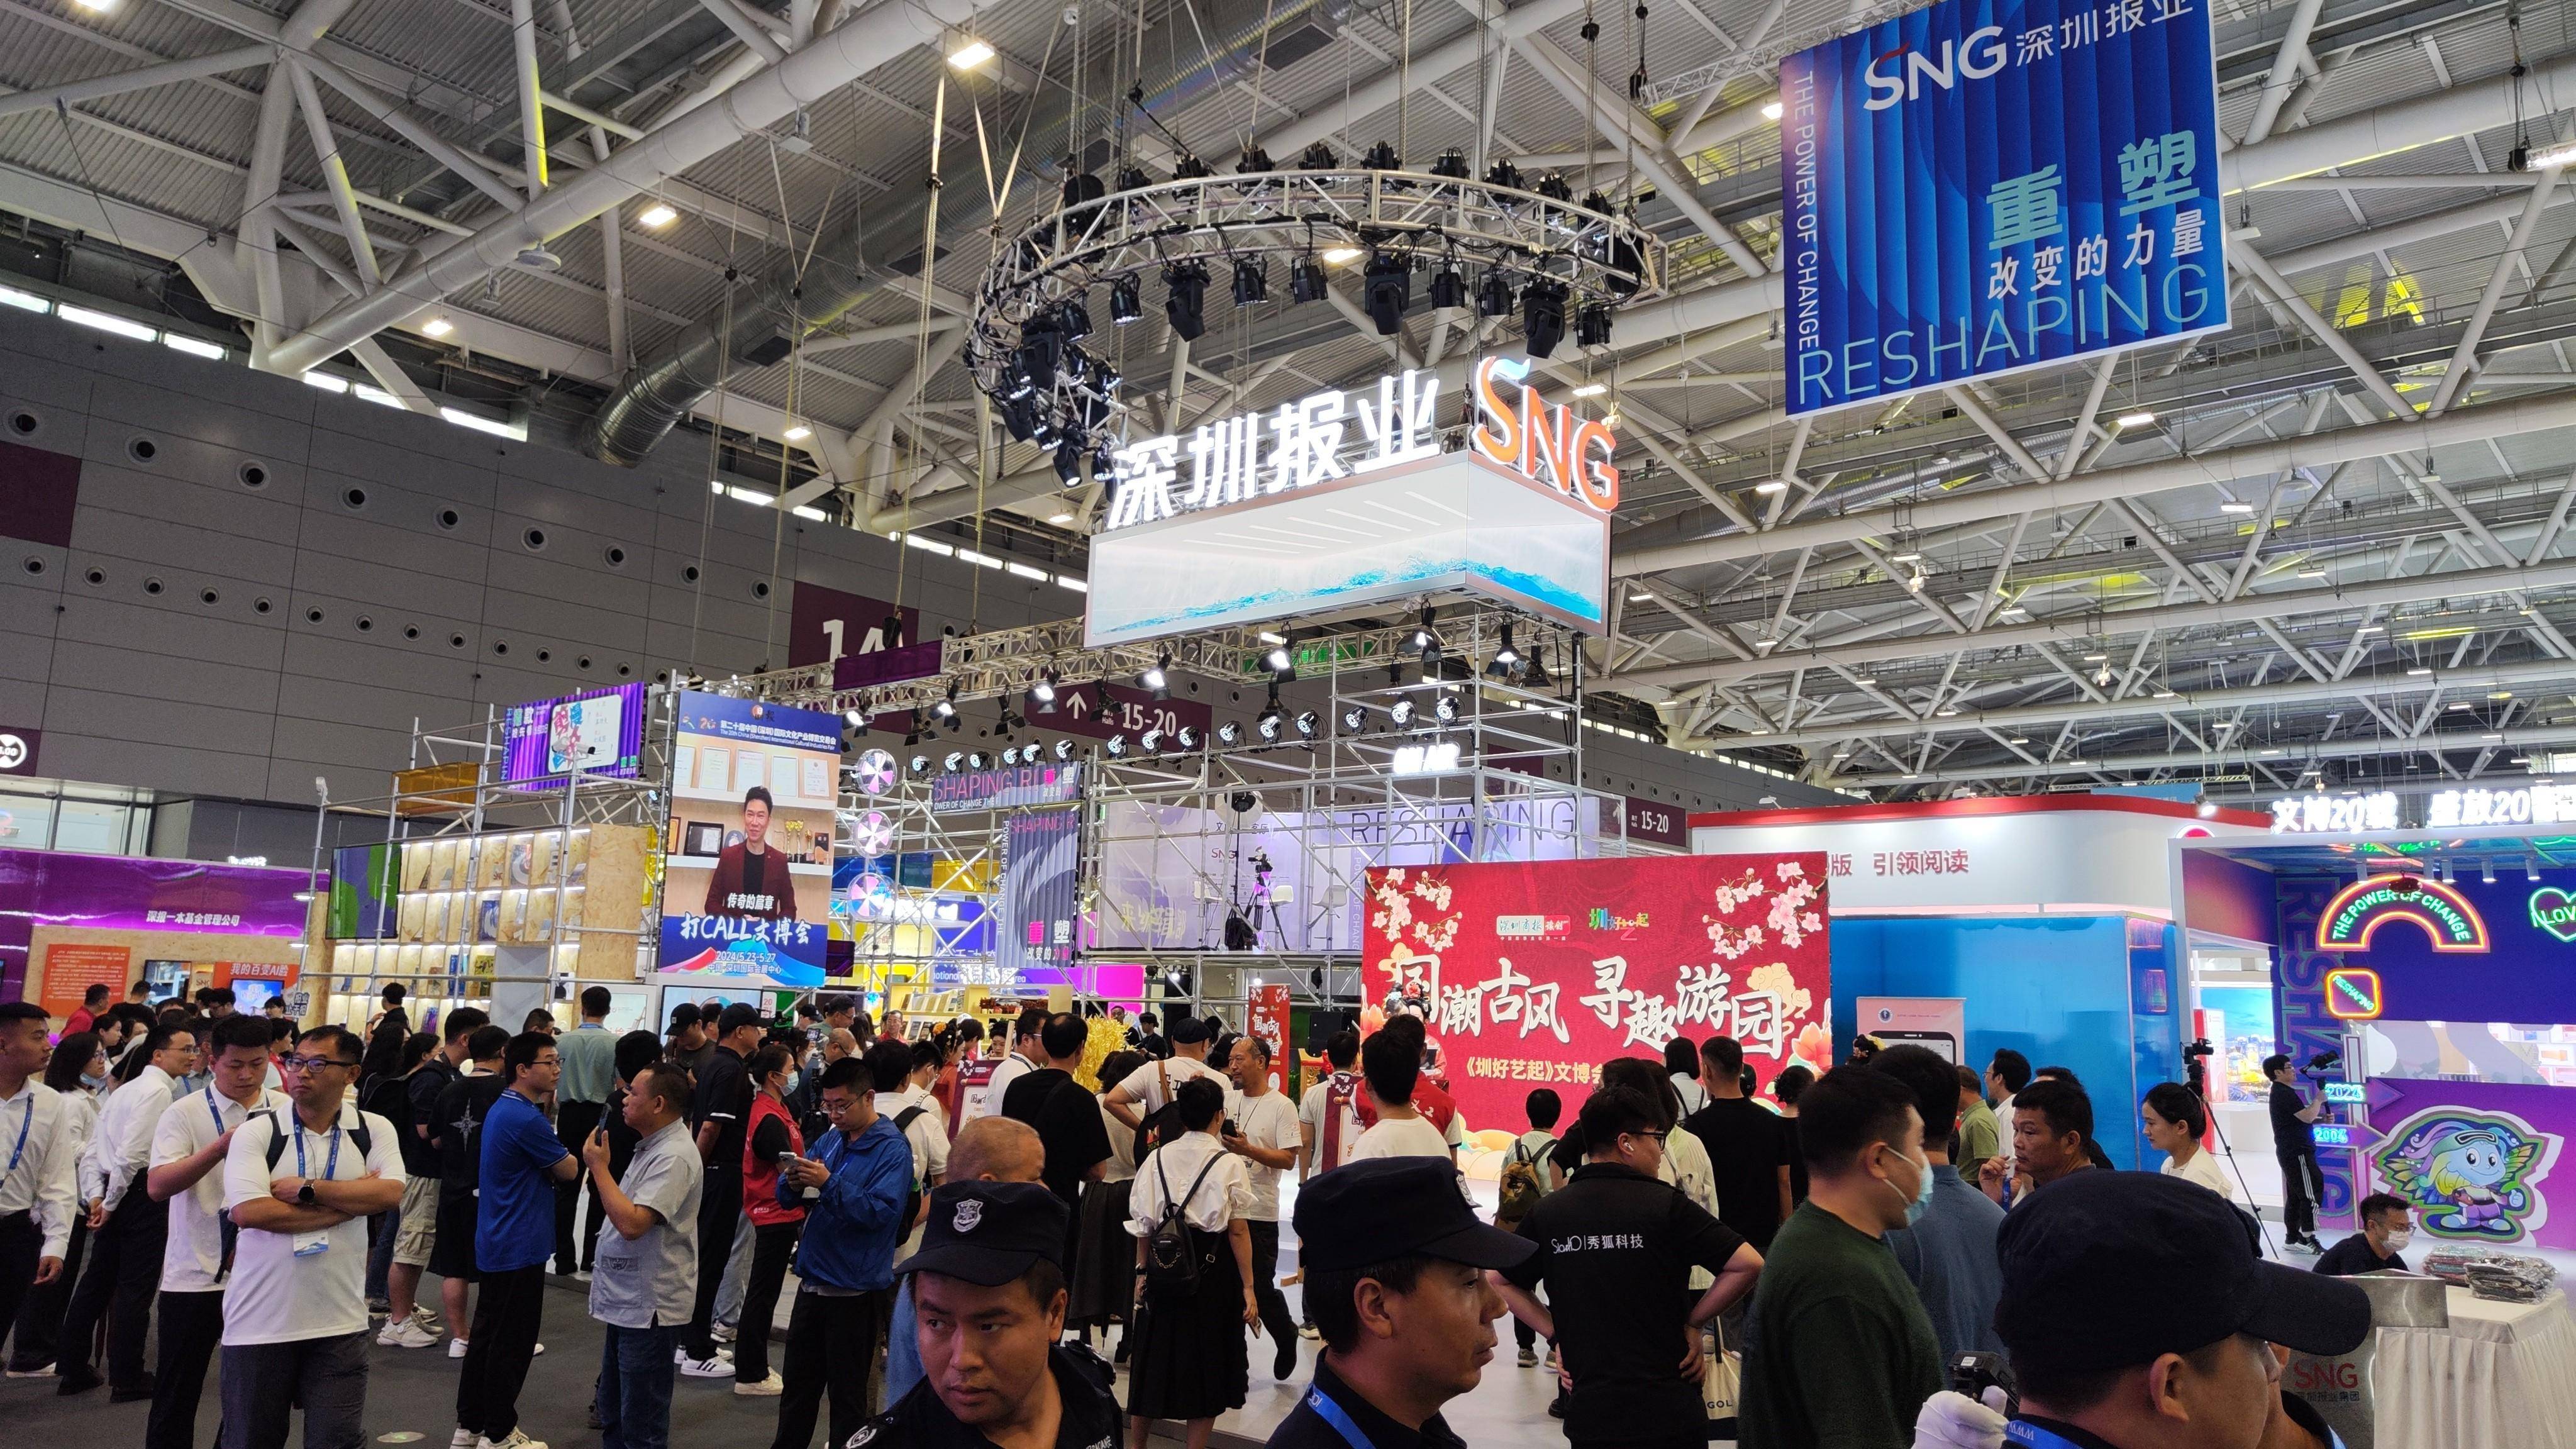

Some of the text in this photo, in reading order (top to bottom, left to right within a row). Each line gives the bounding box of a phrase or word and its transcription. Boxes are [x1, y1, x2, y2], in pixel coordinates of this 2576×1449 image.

[2016, 0, 2193, 67] 深圳报业
[1863, 26, 2008, 111] SNG
[1794, 71, 1819, 351] THE POWER OF CHANGE
[1987, 209, 2206, 300] 改变的力量
[1799, 264, 2208, 404] RESHAPING
[1108, 369, 1441, 529] 深圳报业
[1473, 355, 1619, 513] SNG
[1123, 702, 1177, 737] 15-20
[501, 707, 514, 780] RESHAPIN
[951, 800, 959, 809] OF
[959, 798, 983, 808] CHANGE
[1001, 820, 1009, 855] POWER
[1641, 810, 1669, 834] 15-20
[1001, 858, 1008, 870] OF
[1826, 849, 1969, 877] 版 引领阅读
[727, 892, 775, 911] 传奇的篇章
[999, 874, 1007, 913] CHANGE
[680, 911, 811, 946] 打CALL文博会
[1352, 913, 1360, 950] CHANG
[2333, 912, 2355, 940] THE
[2347, 889, 2398, 918] POWER
[2421, 894, 2472, 942] CHANGE
[230, 962, 289, 977] 我的百变AI脸
[716, 950, 776, 963] 2024/5.23-5.27
[1580, 955, 1784, 1060] 寻趣游园
[2332, 975, 2375, 1011] RESHAPING
[1587, 1233, 1644, 1250] 秀狐科技
[2294, 1362, 2359, 1389] SNG
